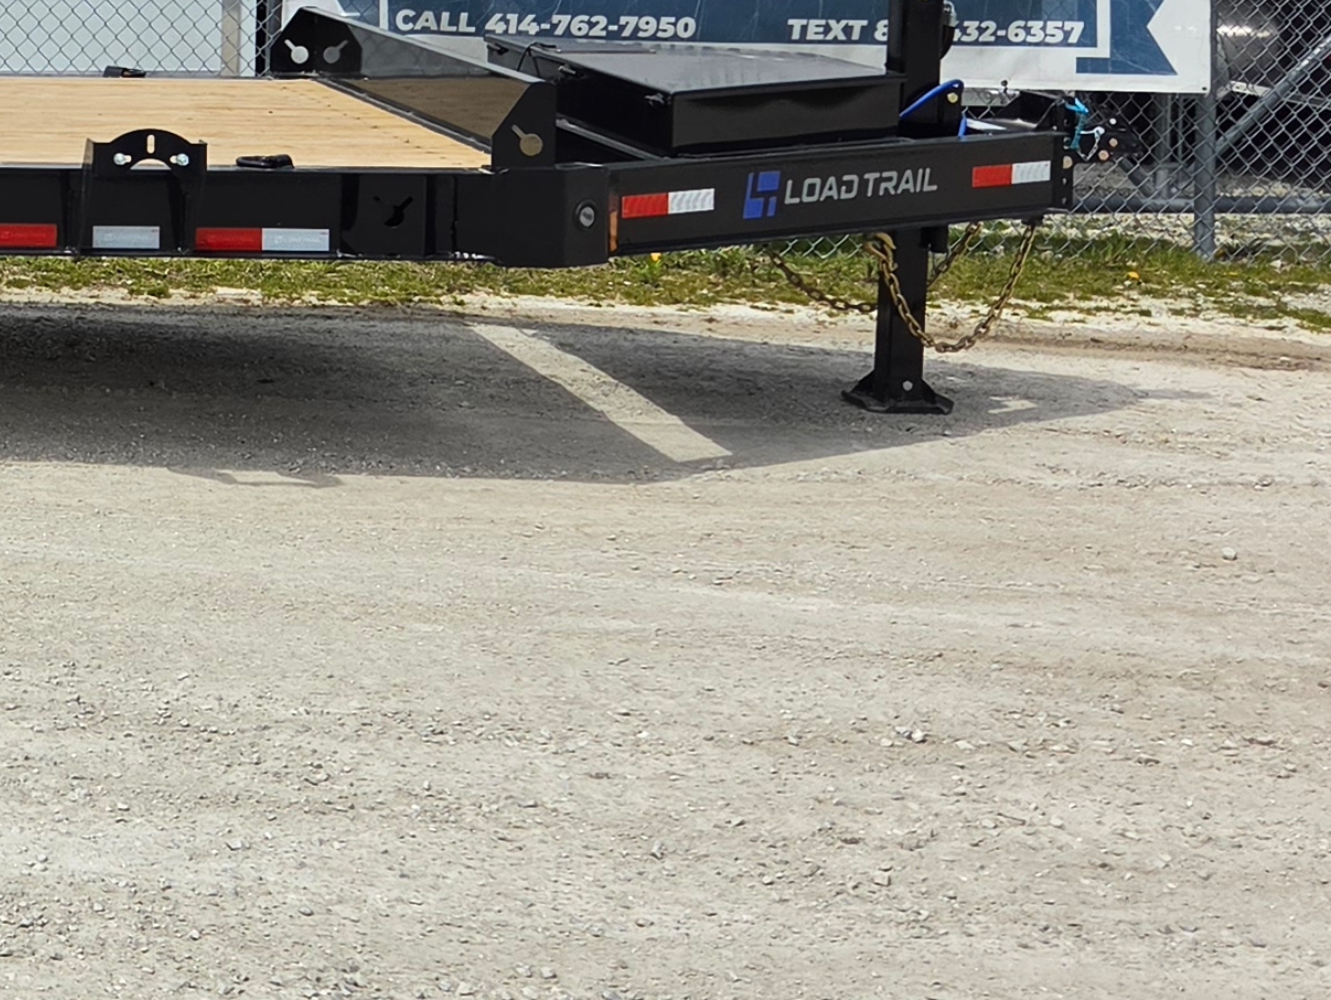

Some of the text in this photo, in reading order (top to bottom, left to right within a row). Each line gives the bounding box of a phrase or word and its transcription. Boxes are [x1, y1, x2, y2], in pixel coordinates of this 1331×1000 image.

[395, 9, 696, 39] CALL 414-762-7950
[788, 19, 868, 41] TEXT
[784, 168, 938, 205] LOAD TRAIL
